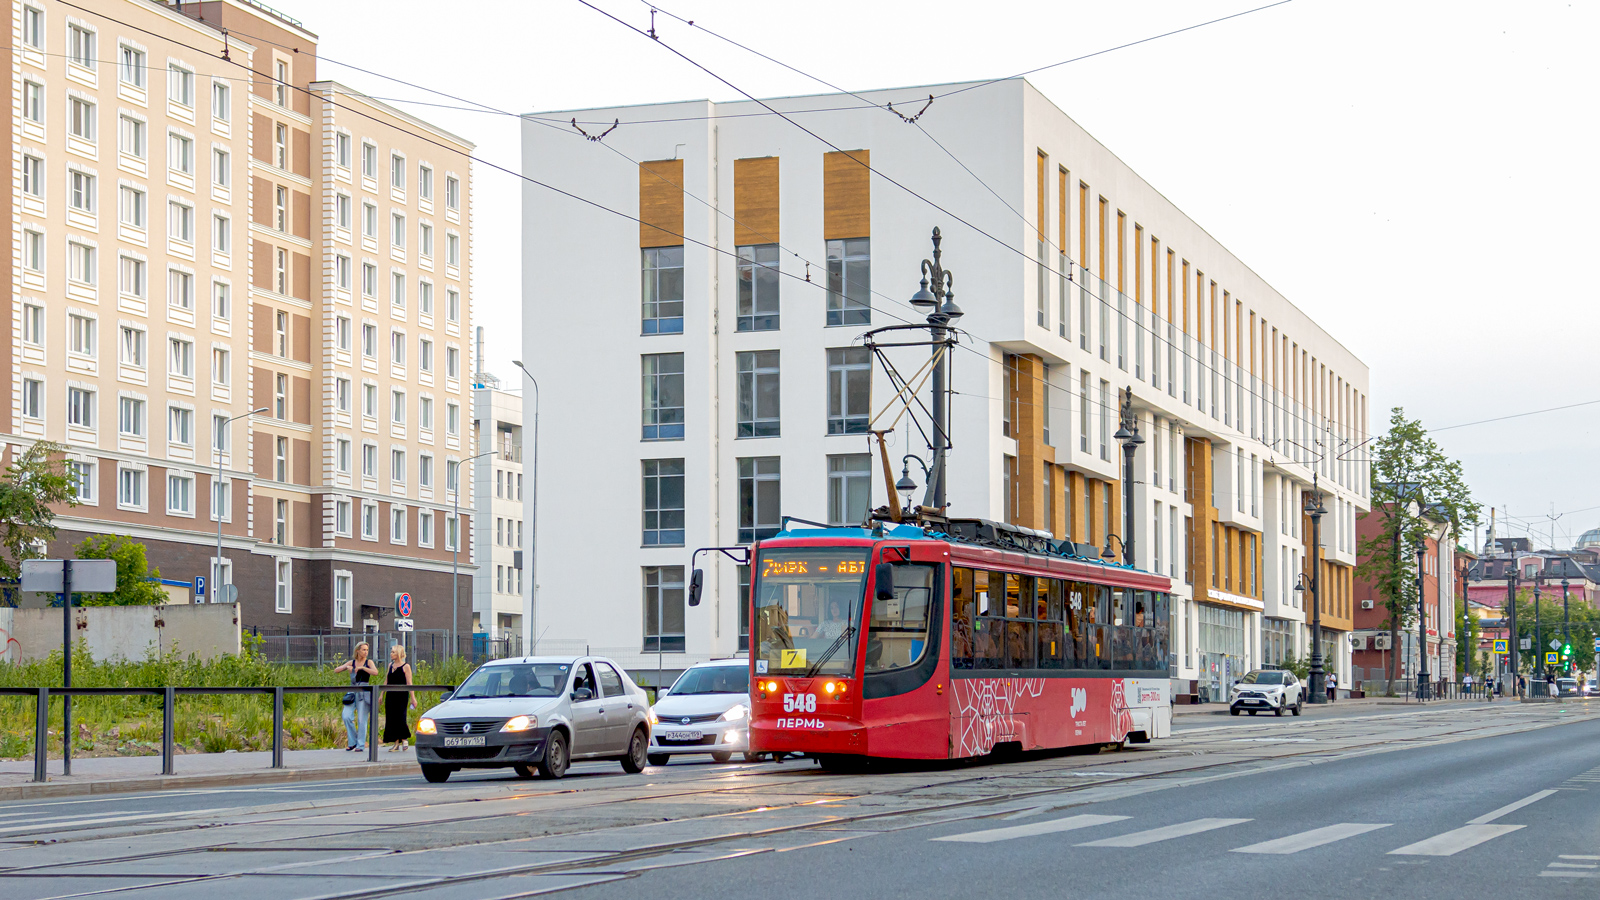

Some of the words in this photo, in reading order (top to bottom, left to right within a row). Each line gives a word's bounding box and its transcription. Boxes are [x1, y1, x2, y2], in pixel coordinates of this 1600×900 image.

[763, 559, 774, 577] 7
[197, 578, 204, 594] P
[1069, 591, 1082, 610] 548
[786, 650, 799, 666] 7
[783, 693, 817, 713] 548
[776, 718, 826, 729] ПЕРМЬ
